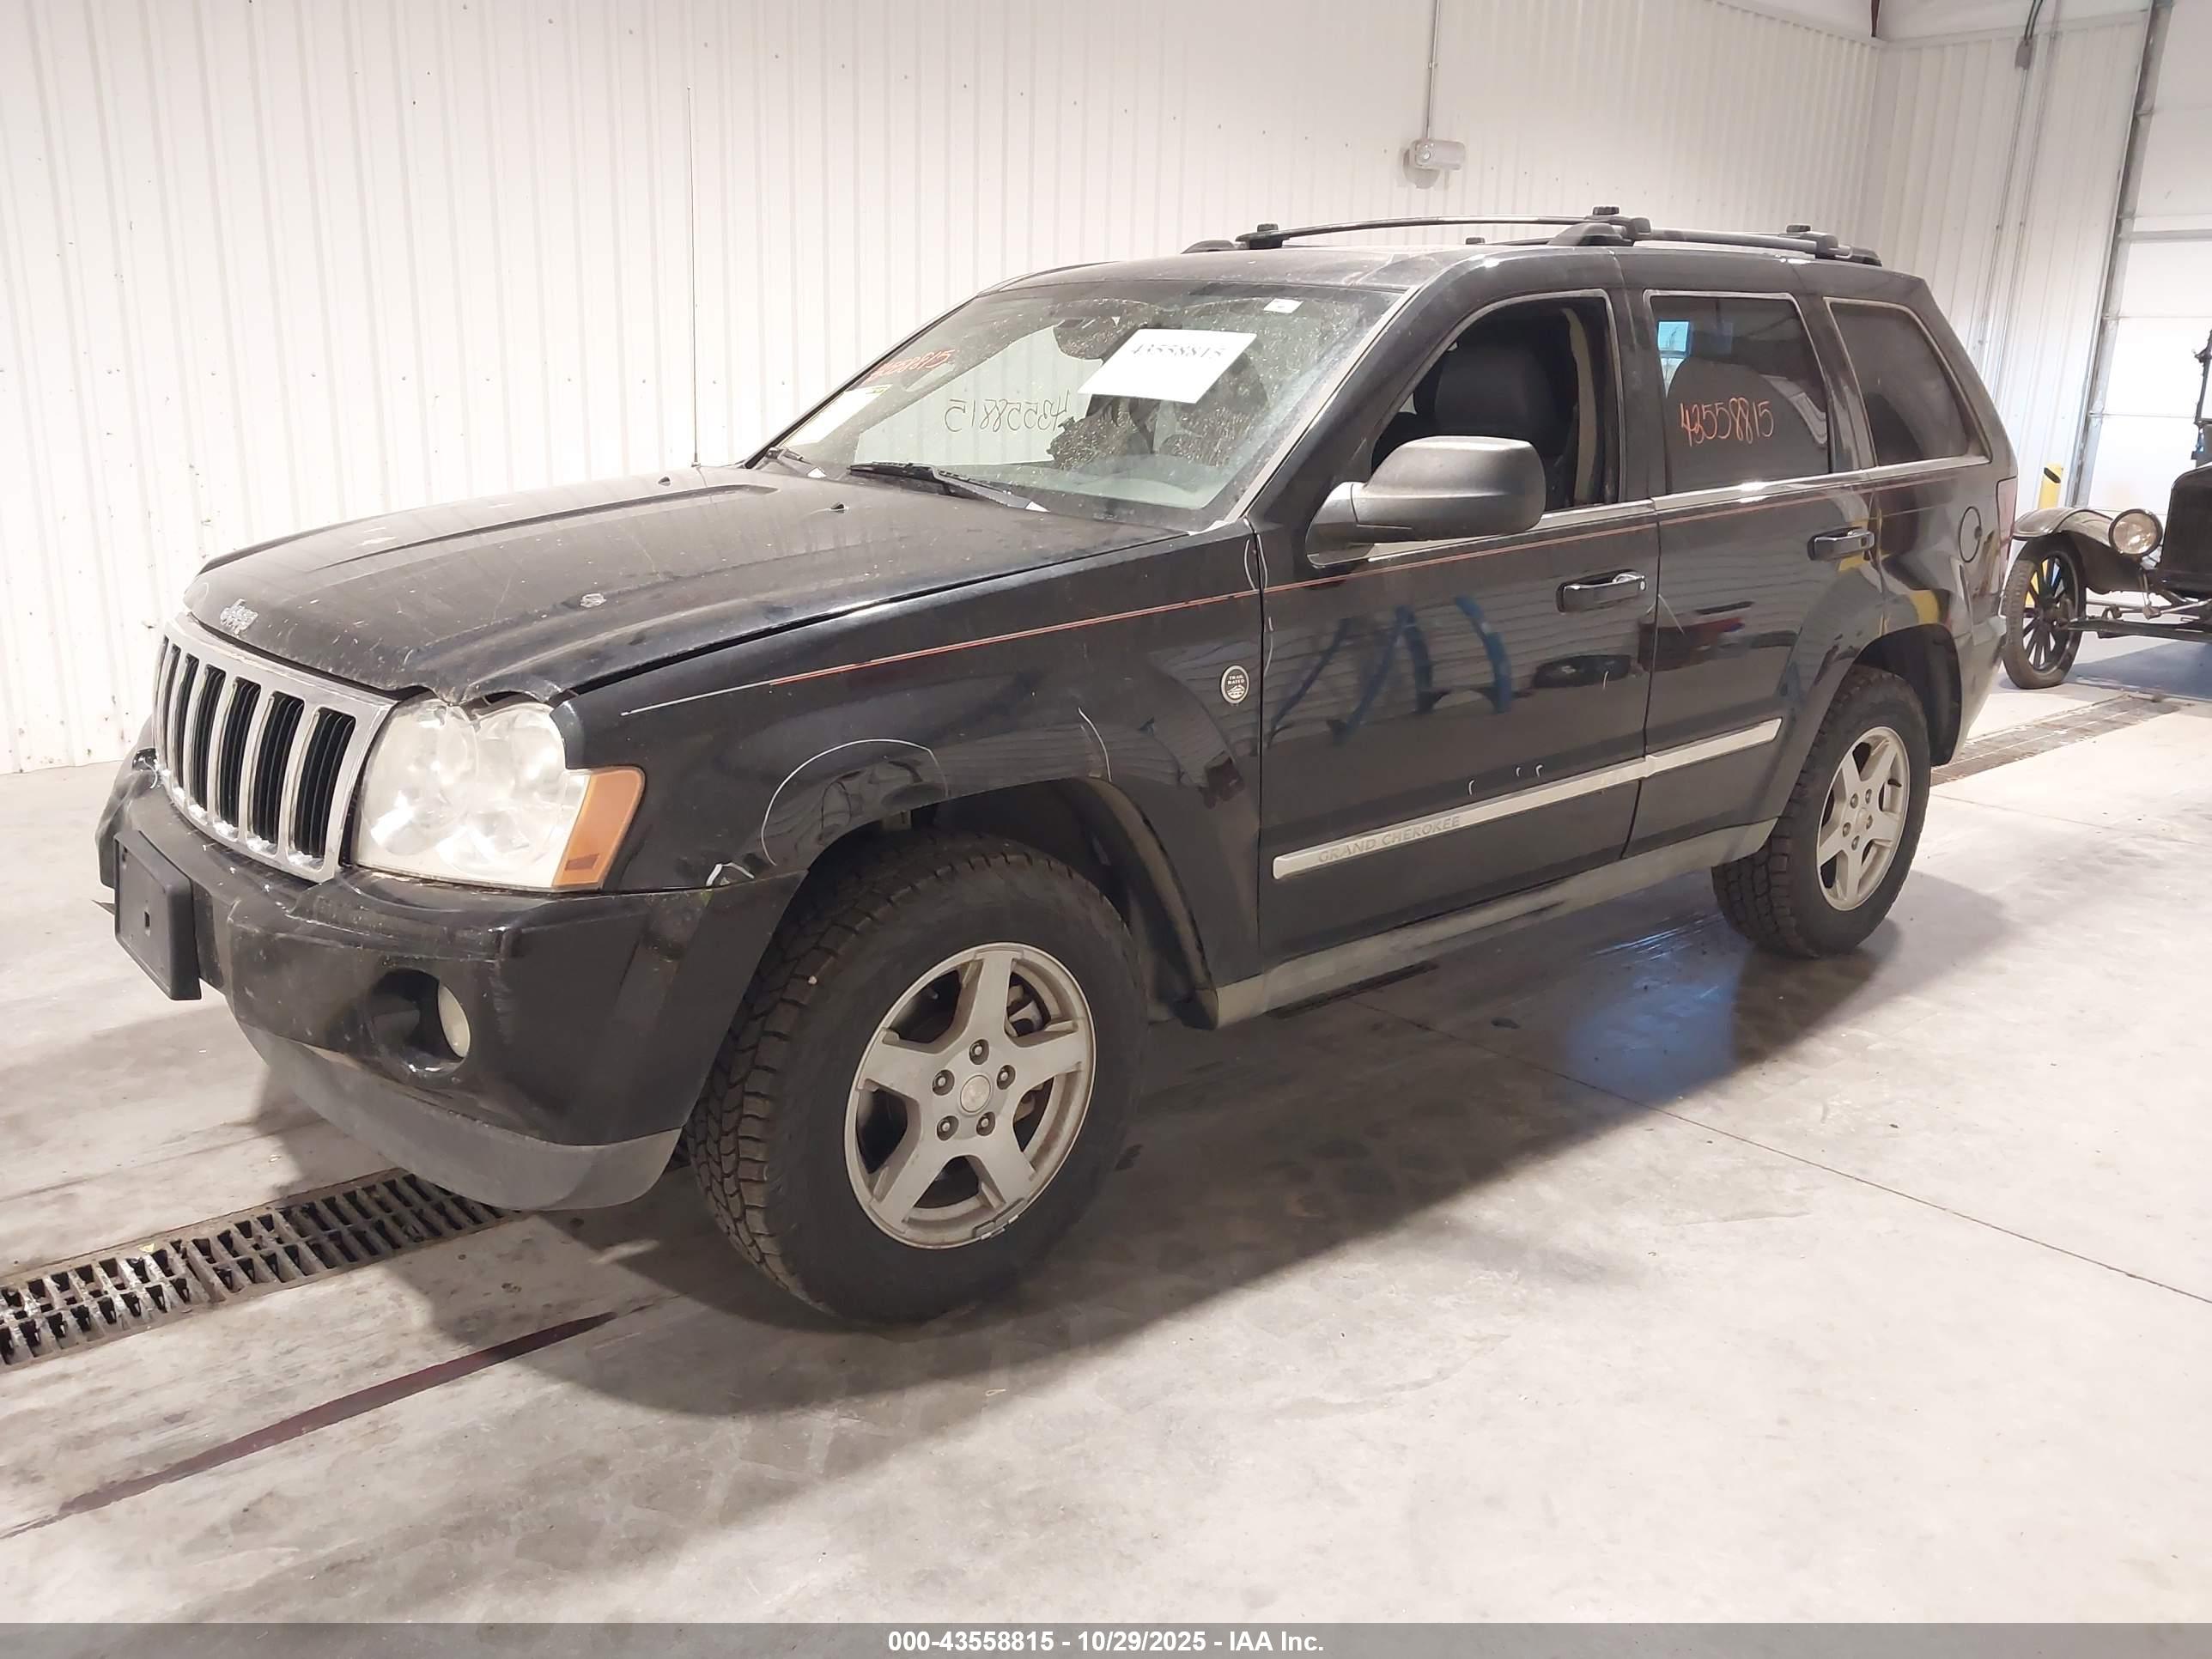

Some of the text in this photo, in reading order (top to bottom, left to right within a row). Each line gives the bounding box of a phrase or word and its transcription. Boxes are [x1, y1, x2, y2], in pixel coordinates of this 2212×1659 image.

[1680, 397, 1774, 447] 43558815
[1318, 815, 1462, 863] GRAND CHEROKEE
